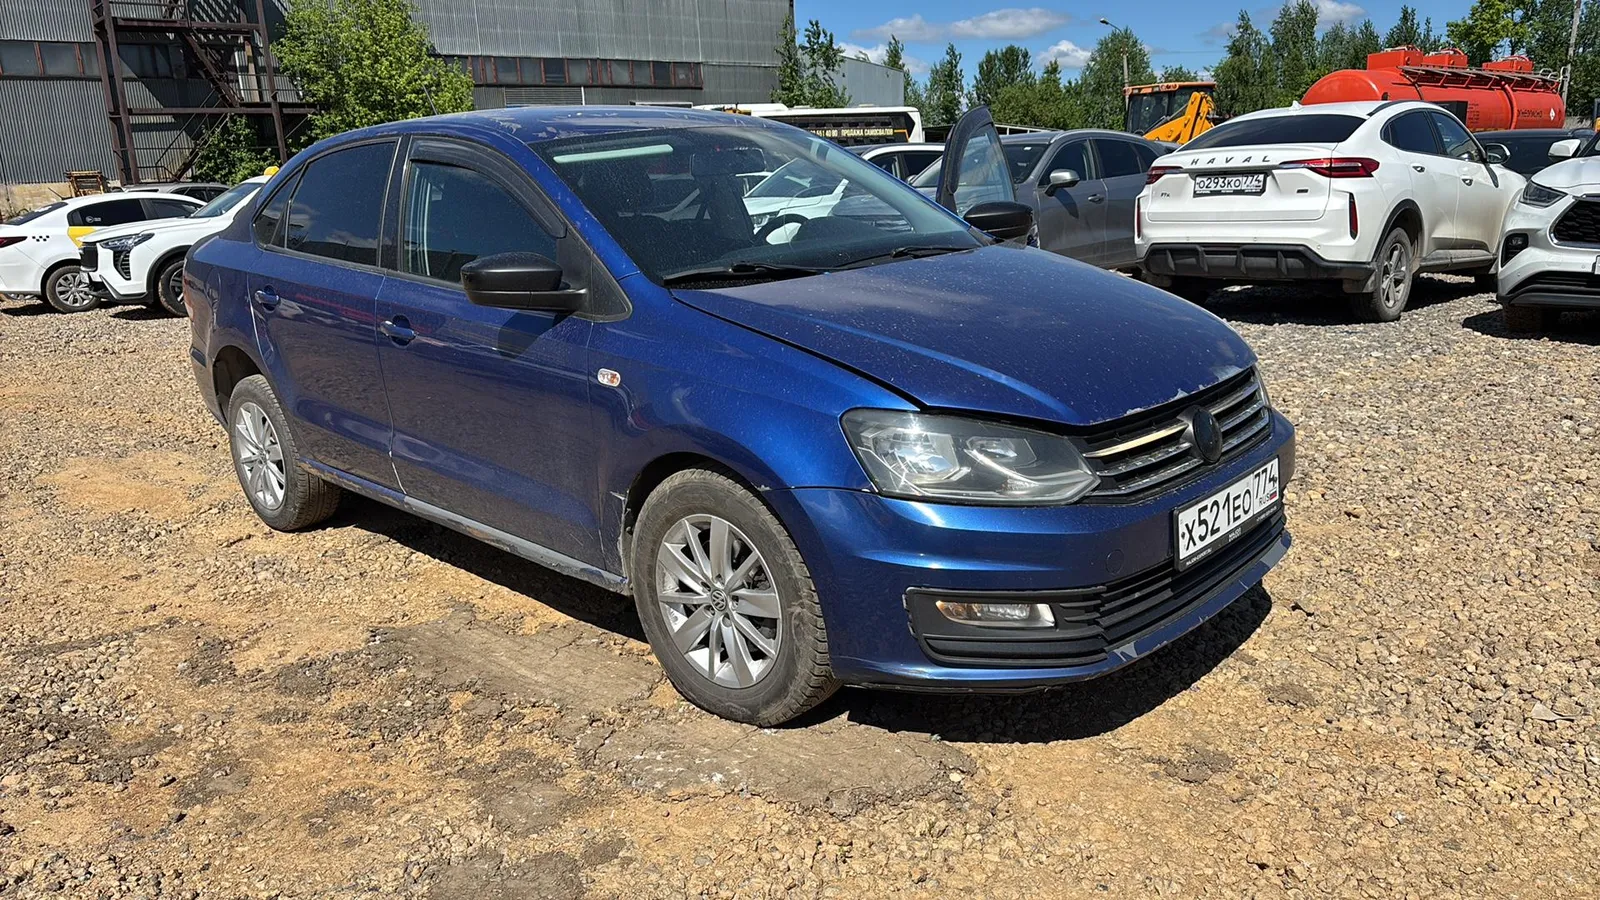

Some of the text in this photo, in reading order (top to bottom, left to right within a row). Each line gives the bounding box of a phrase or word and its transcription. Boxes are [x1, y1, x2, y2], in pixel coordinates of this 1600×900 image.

[841, 129, 863, 137] ПРОДАЖА
[864, 128, 893, 136] САМОСВАЛОВ
[1190, 156, 1270, 166] HAVAL
[1243, 175, 1261, 185] 774
[1259, 492, 1270, 507] RUS
[1185, 463, 1277, 551] Х521ЕО 774
